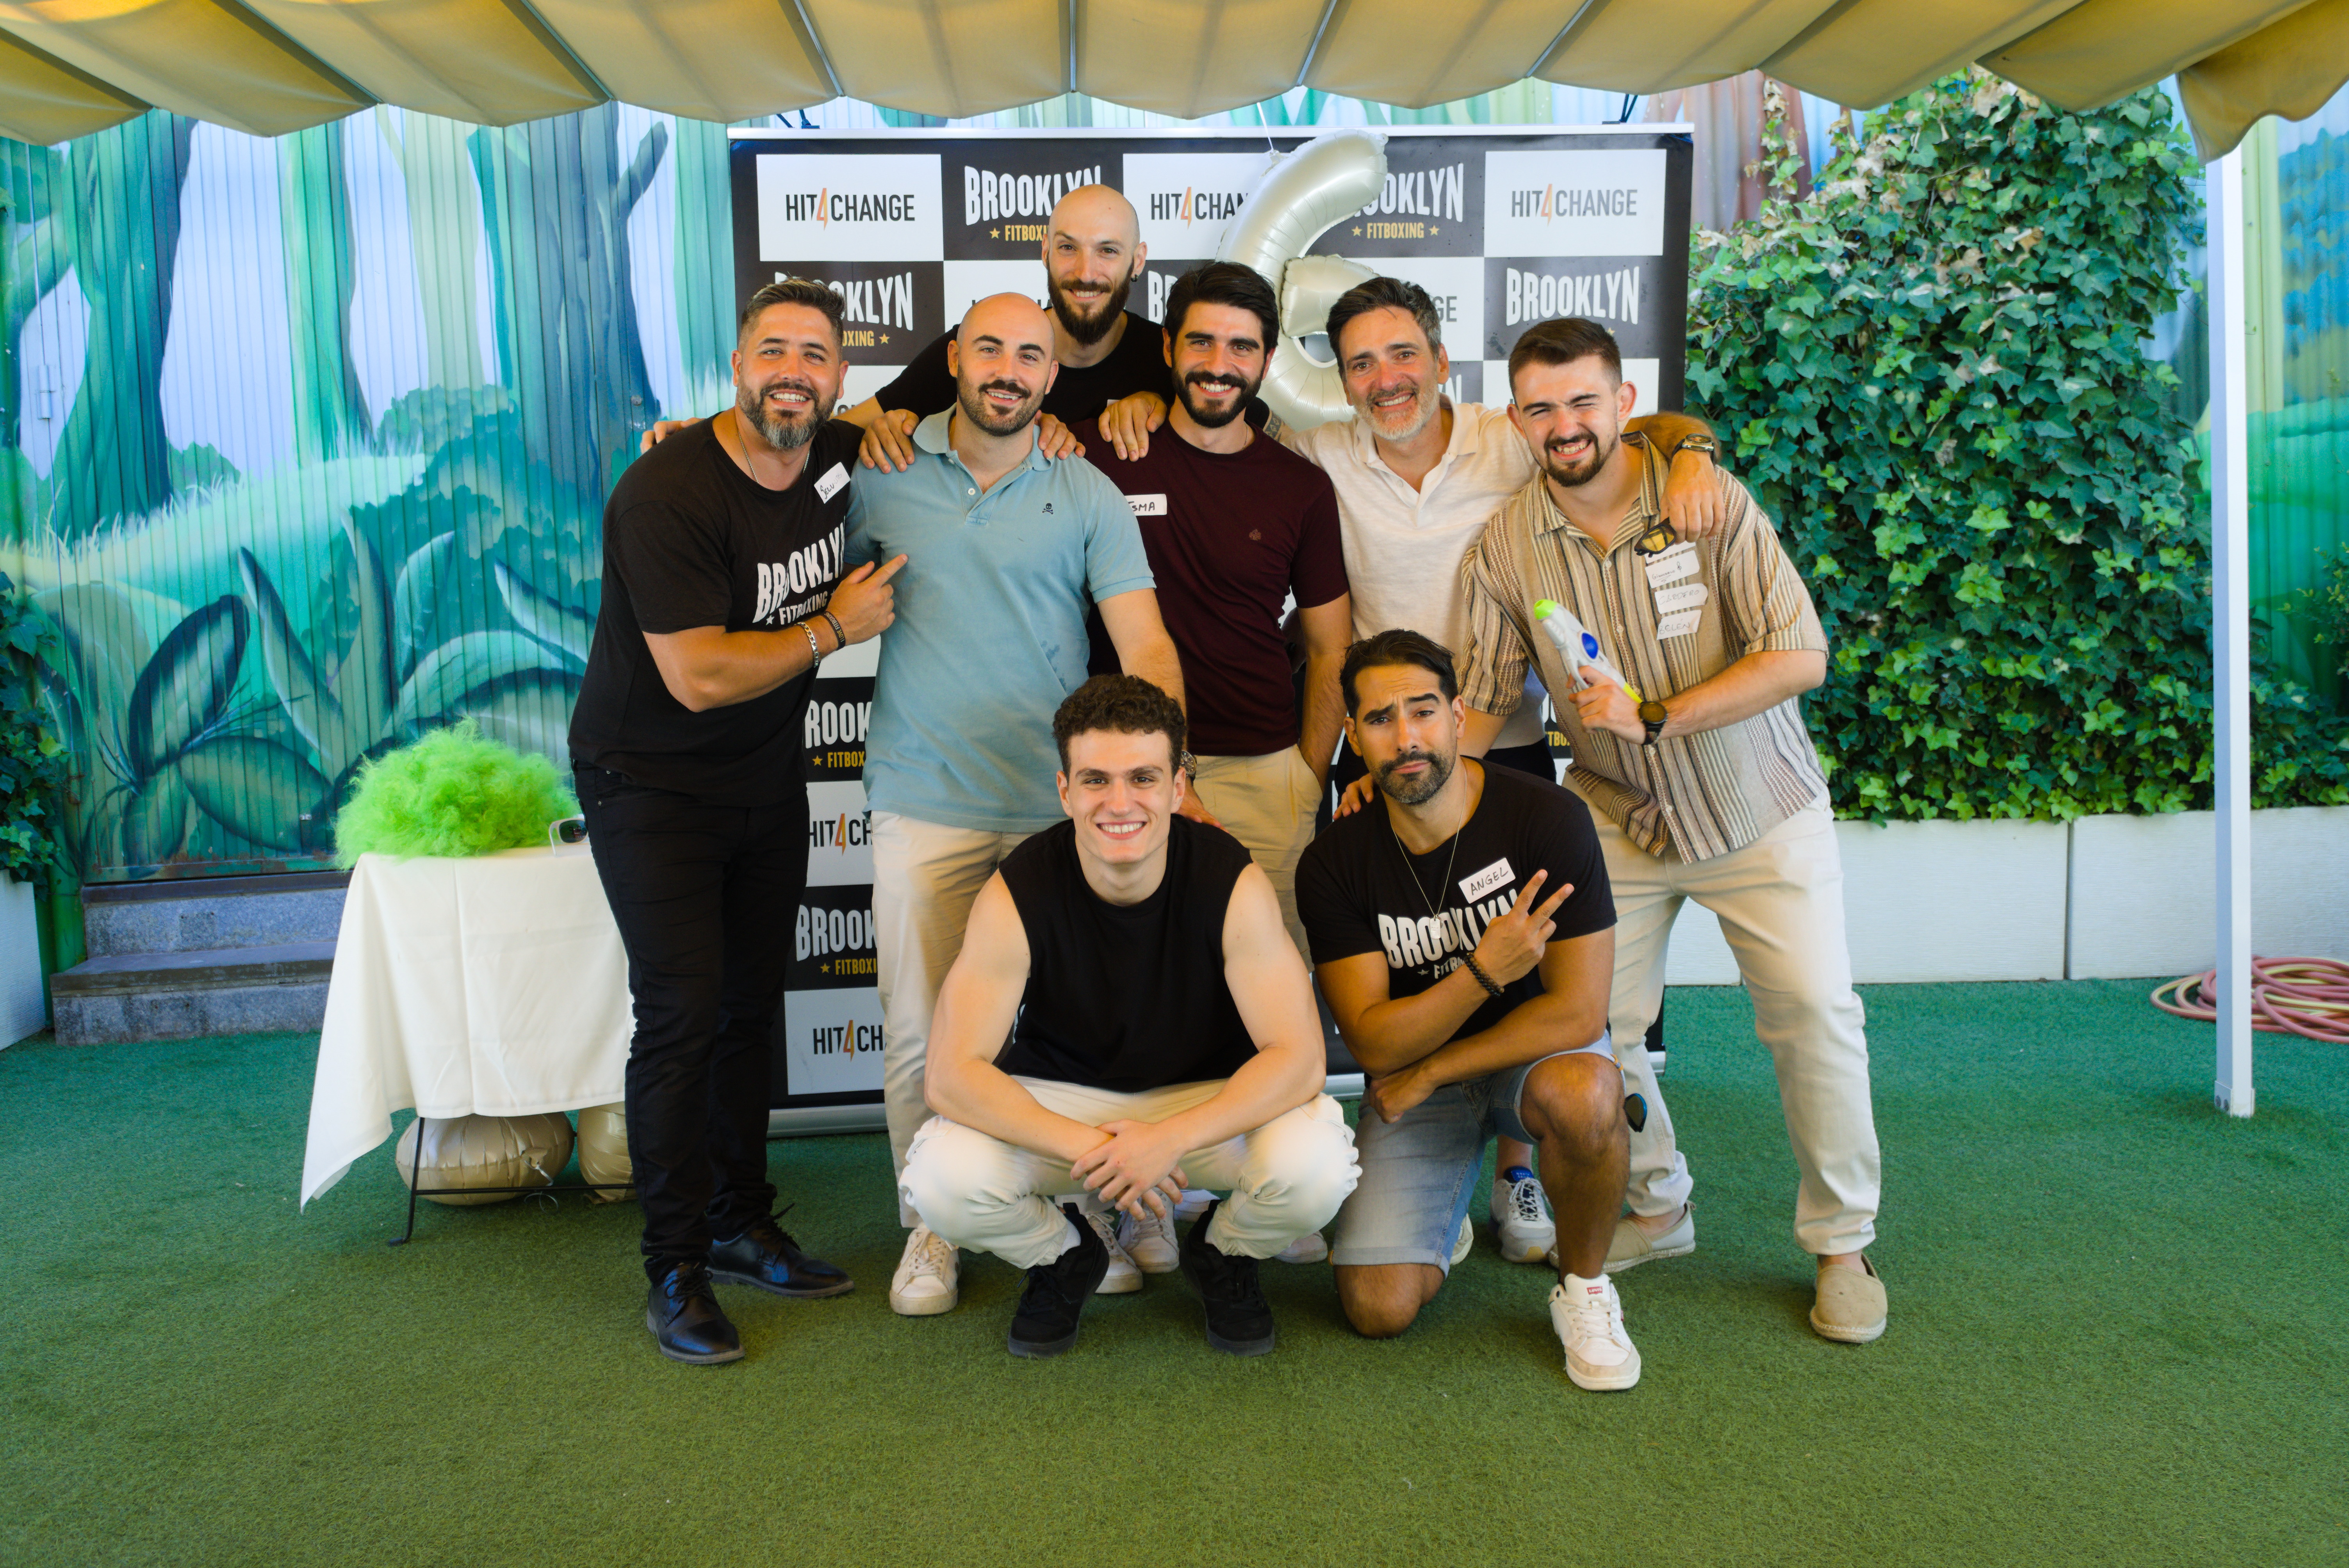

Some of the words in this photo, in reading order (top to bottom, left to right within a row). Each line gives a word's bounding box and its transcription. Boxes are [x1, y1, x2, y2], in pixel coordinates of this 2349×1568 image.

[786, 187, 915, 231] HIT4CHANGE
[1354, 162, 1464, 223] OKLYN
[1512, 184, 1638, 227] HIT4CHANGE
[1005, 225, 1050, 241] FITBOXI
[1367, 222, 1425, 239] FITBOXING
[775, 271, 913, 331] KLYN
[1506, 266, 1640, 326] BROOKLYN
[1128, 501, 1155, 511] SMA
[1659, 618, 1690, 634] BELÉN
[1470, 867, 1509, 896] ANGEL
[813, 1020, 887, 1062] HIT4CH
